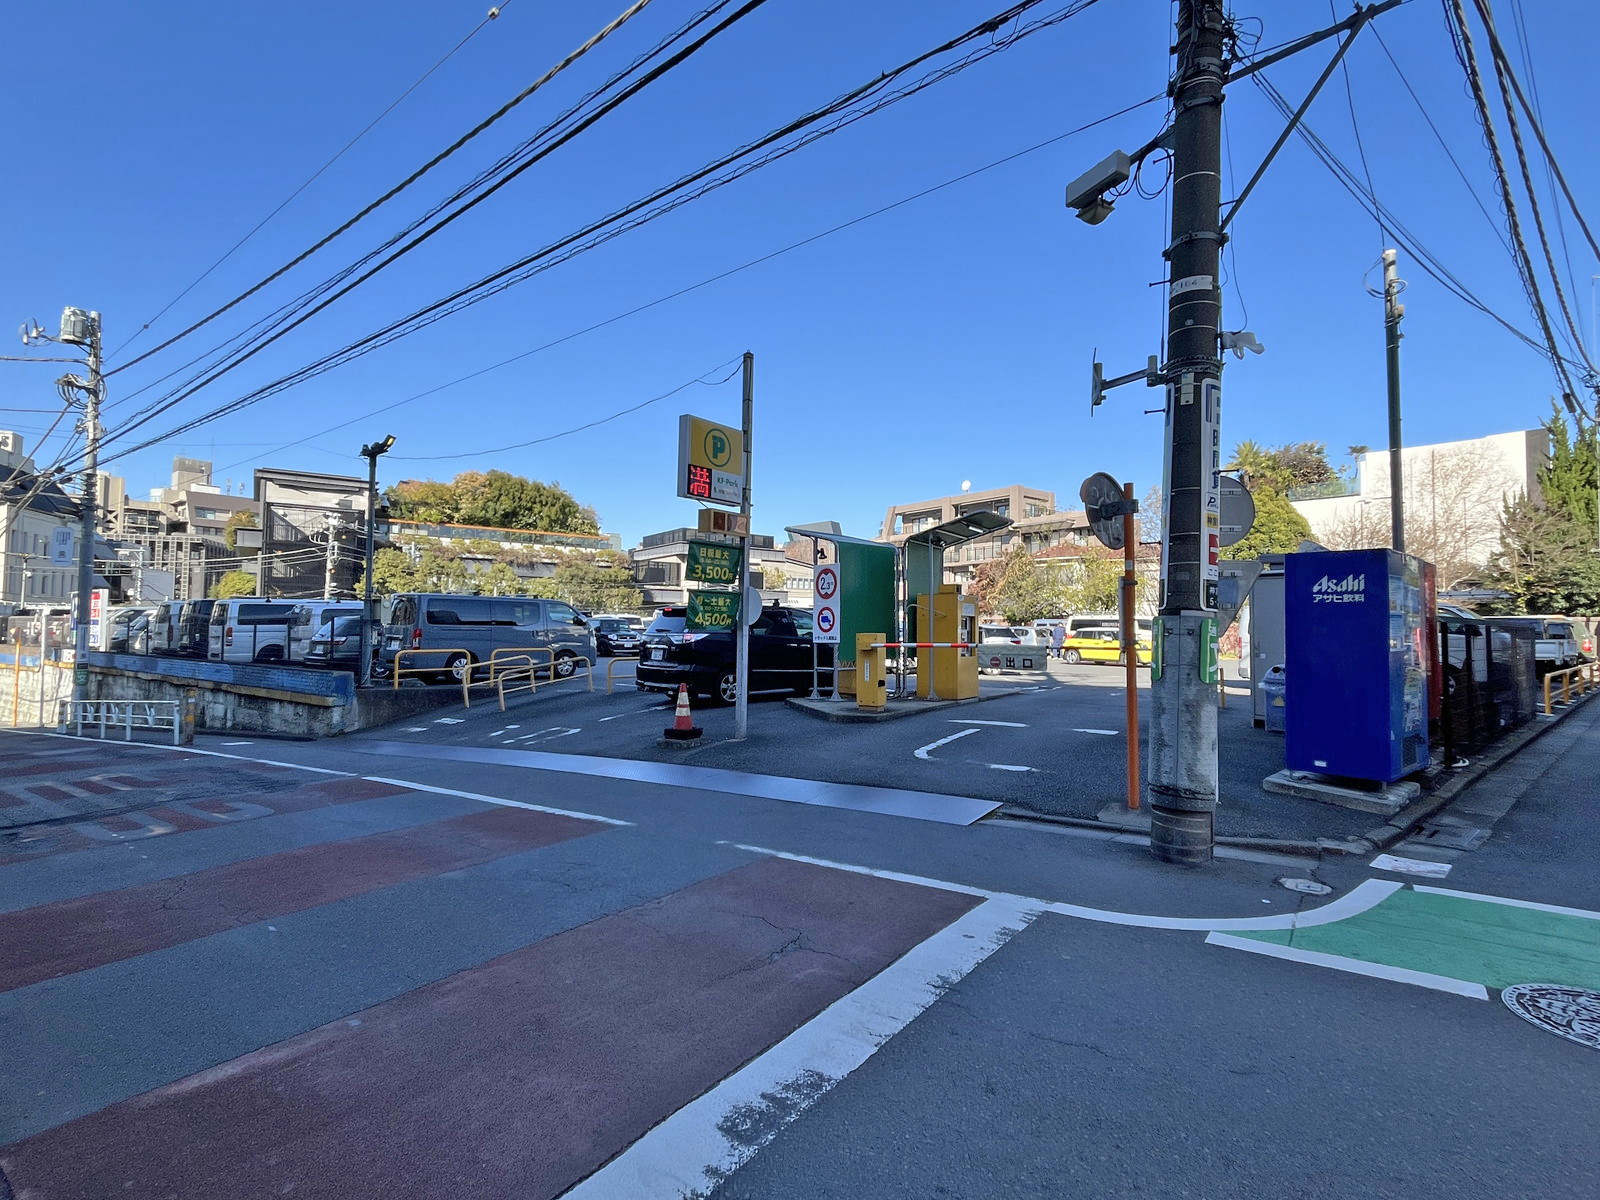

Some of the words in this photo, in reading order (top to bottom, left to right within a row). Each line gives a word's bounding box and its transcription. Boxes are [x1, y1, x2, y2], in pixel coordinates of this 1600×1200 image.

[711, 435, 726, 460] P
[690, 466, 710, 498] 満
[1313, 574, 1365, 592] Asahi
[1313, 594, 1365, 602] アサヒ飲料
[1005, 657, 1033, 668] 出口
